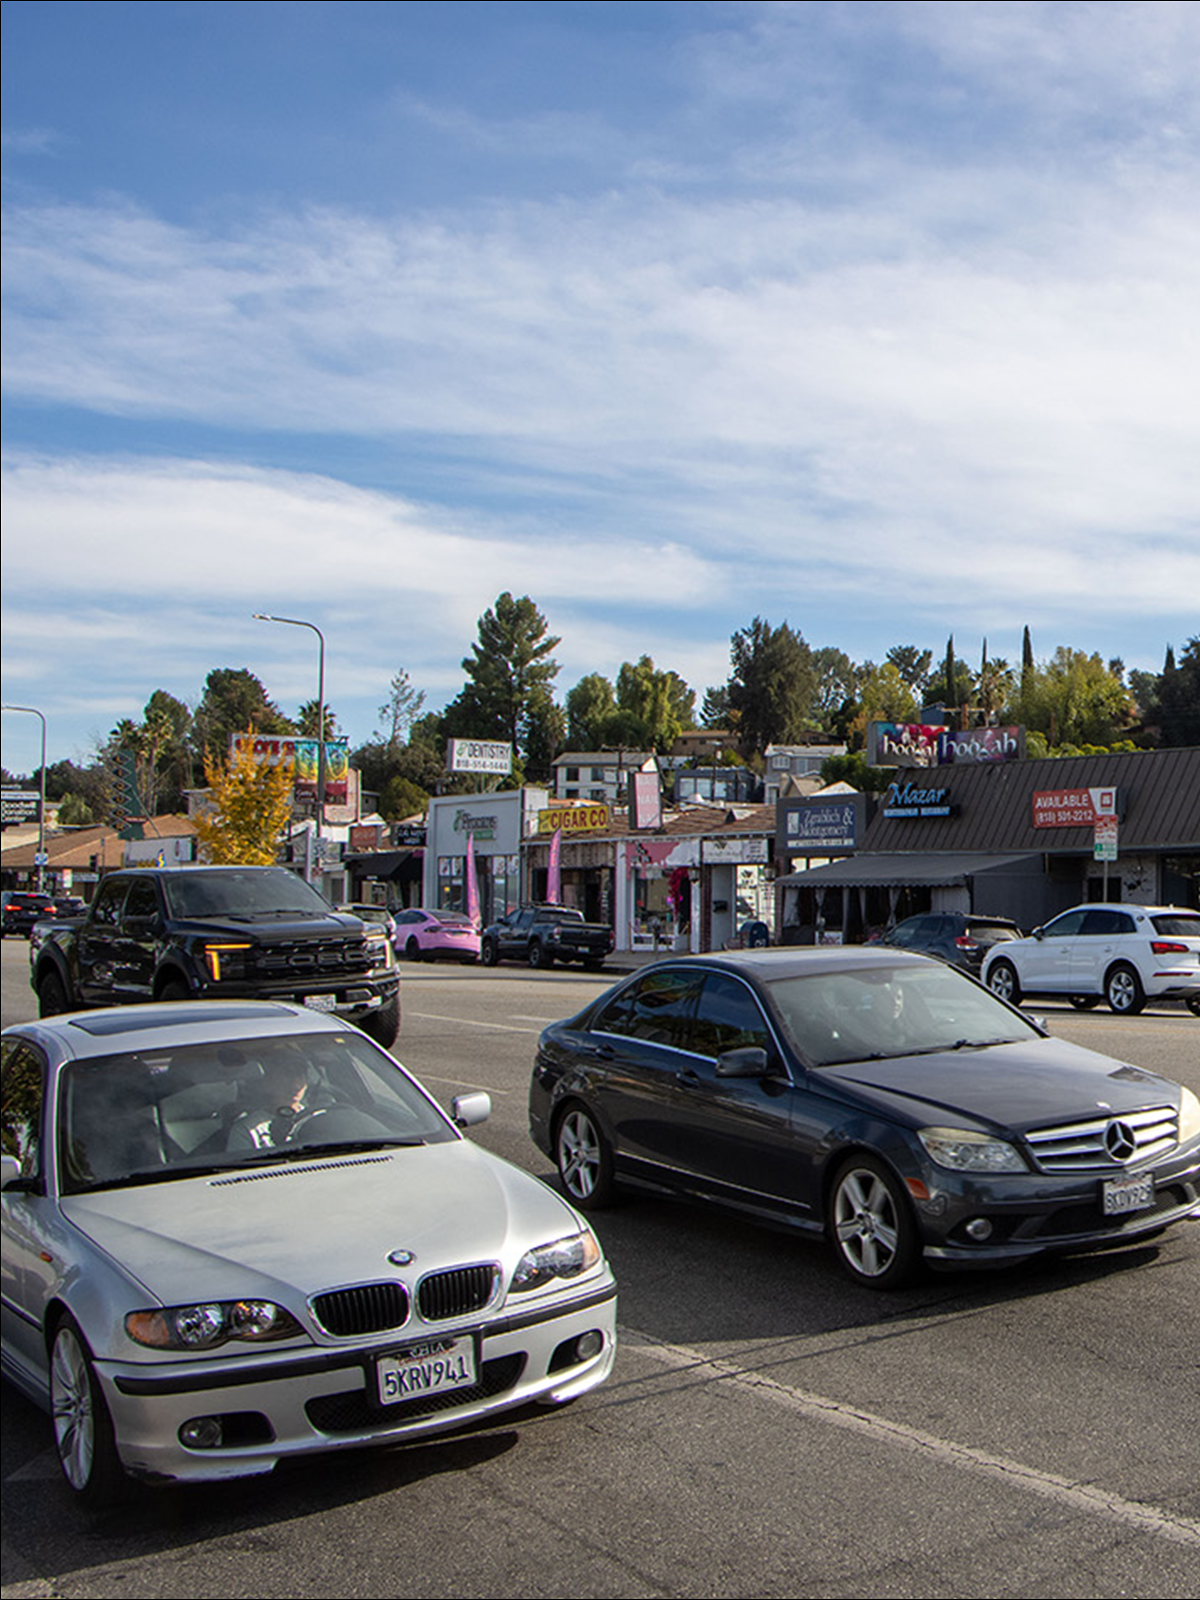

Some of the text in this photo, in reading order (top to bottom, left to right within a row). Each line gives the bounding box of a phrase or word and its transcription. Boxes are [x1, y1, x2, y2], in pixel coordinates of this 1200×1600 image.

[468, 742, 510, 759] DENTISTRY
[888, 782, 946, 805] Mazar
[1035, 794, 1089, 809] AVAILABLE
[551, 808, 607, 829] CIGAR CO
[842, 807, 854, 825] &
[385, 1355, 469, 1396] 5KRV941
